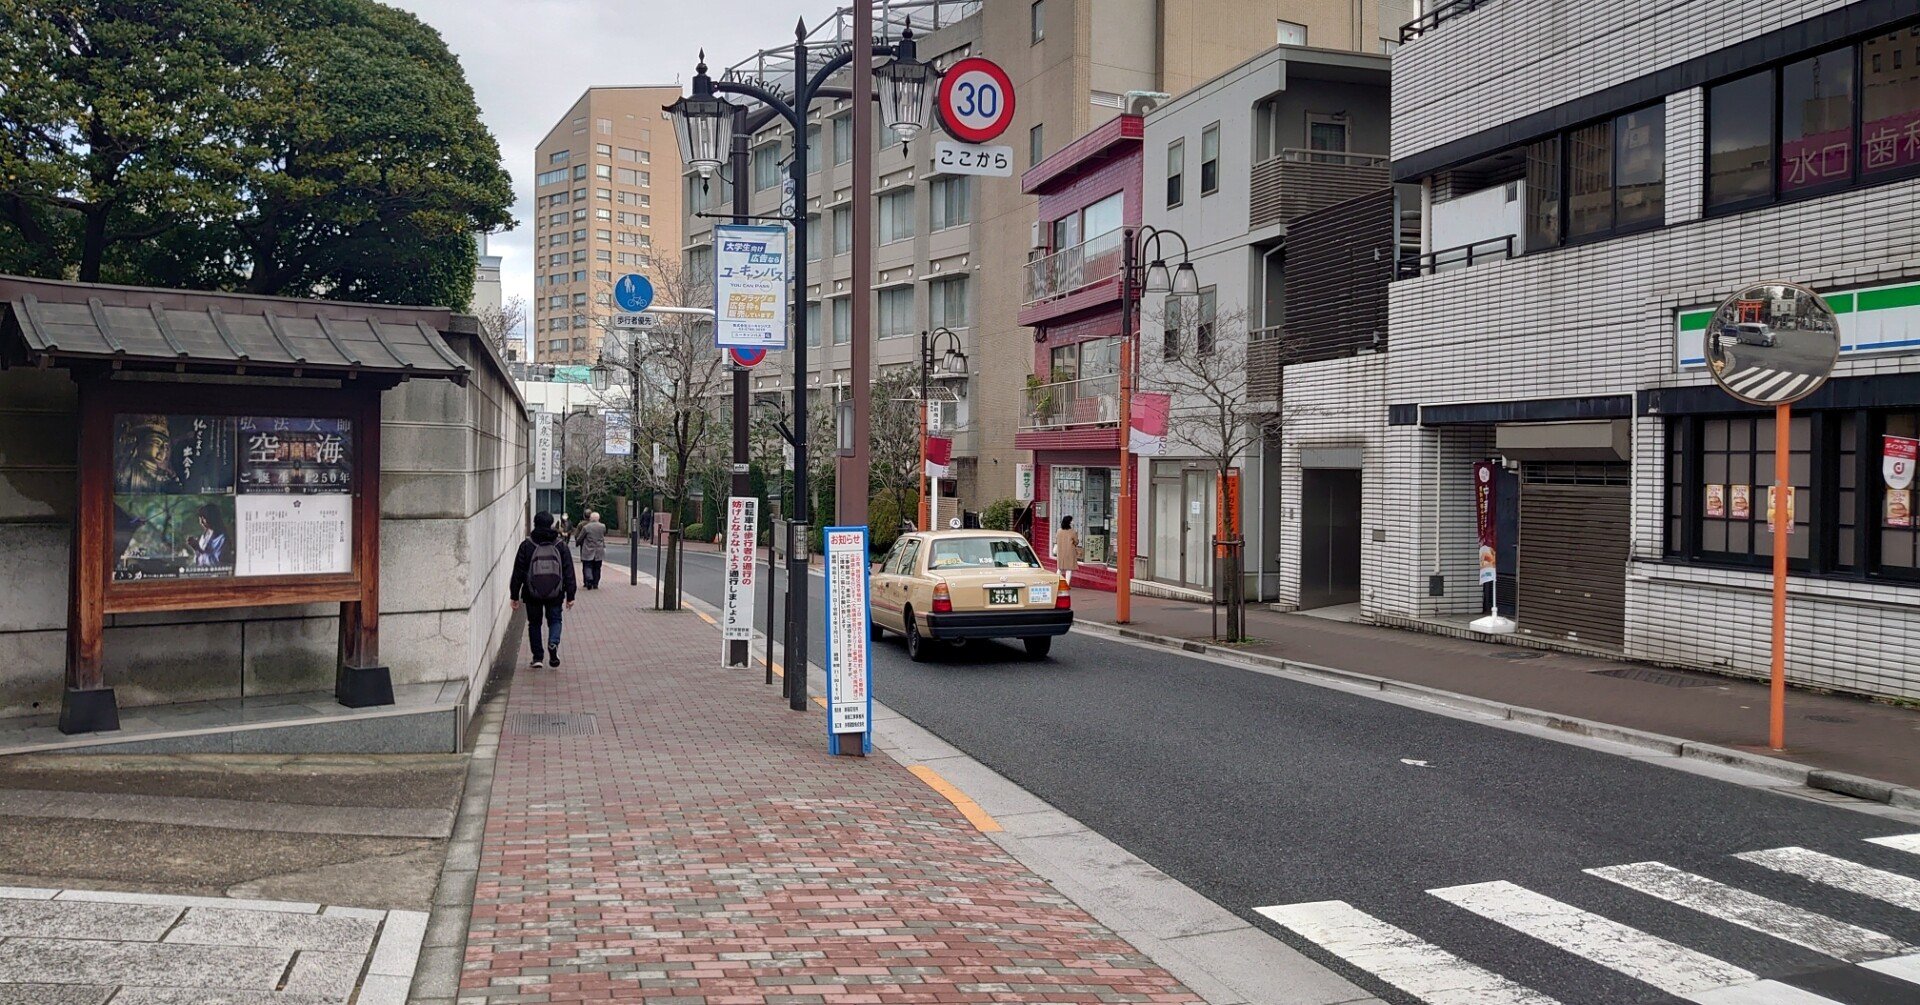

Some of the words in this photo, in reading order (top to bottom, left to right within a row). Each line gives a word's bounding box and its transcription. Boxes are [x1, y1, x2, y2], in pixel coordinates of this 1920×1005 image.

[819, 35, 889, 64] Nanon
[729, 70, 786, 101] Waseda
[957, 82, 997, 118] 30
[941, 149, 1008, 169] ここから
[725, 242, 764, 252] 大学生向け
[750, 254, 780, 263] 広告なら
[617, 316, 651, 325] 歩行者優先
[240, 416, 351, 432] 弘法大師
[248, 432, 344, 463] 空海
[742, 501, 755, 586] 自転車は歩行者の通行の
[831, 535, 860, 545] お知らせ
[727, 500, 743, 624] 妨げとならないよう通行しましょう
[995, 594, 1018, 604] 52-84
